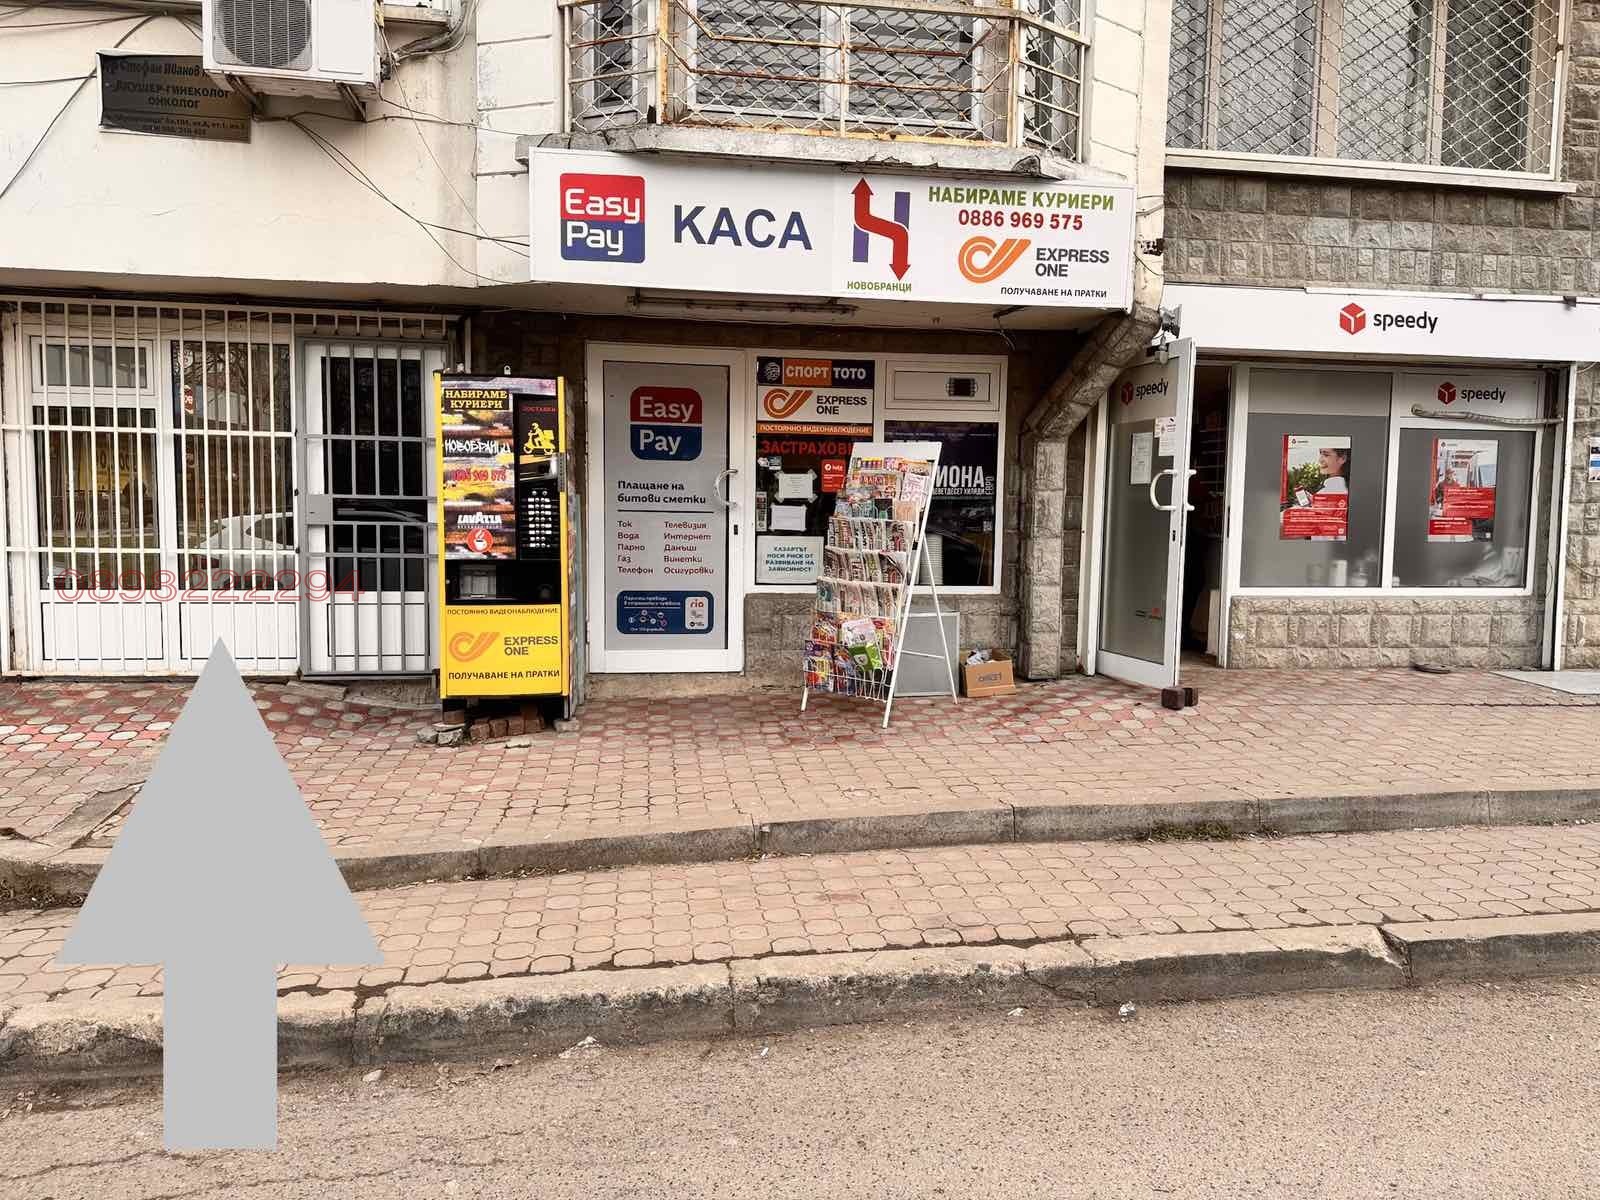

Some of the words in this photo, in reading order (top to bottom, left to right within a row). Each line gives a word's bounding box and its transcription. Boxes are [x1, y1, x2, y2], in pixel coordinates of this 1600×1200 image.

[928, 186, 1026, 207] НАБИРАМЕ
[1033, 192, 1114, 211] КУРИЕРИ
[565, 188, 640, 224] Easy
[958, 210, 1004, 227] 0886
[1011, 212, 1043, 229] 969
[1050, 214, 1083, 230] 575
[674, 205, 813, 250] КАСА
[566, 221, 624, 256] Pay
[1036, 247, 1110, 263] EXPRESS
[1035, 263, 1068, 277] ONE
[847, 281, 912, 293] НОВОБРАНЦИ
[1000, 286, 1058, 297] ПОЛУЧАВАНЕ
[1060, 288, 1072, 297] НА
[1074, 289, 1107, 298] ПРАТКИ
[1373, 311, 1438, 334] speedy
[785, 365, 829, 378] СПОРТ
[833, 367, 866, 379] ТОТО
[445, 390, 507, 399] НАБИРАМЕ
[1136, 378, 1169, 400] speedy
[817, 395, 867, 406] EXPRESS
[1461, 387, 1506, 403] speedy
[450, 400, 503, 408] КУРИЕРИ
[639, 396, 694, 422] Easy
[817, 406, 839, 415] ONE
[639, 429, 682, 455] Pay
[935, 465, 985, 487] ИОНА
[617, 480, 669, 491] Плащане
[671, 483, 685, 491] на
[617, 493, 661, 503] битови
[662, 494, 706, 504] сметки
[457, 511, 502, 524] LAVAZZA
[617, 520, 632, 528] Ток
[664, 521, 707, 530] Телевизия
[617, 532, 640, 541] Вода
[664, 533, 712, 541] Интернет
[617, 543, 645, 552] Парно
[664, 544, 697, 552] Данъци
[617, 555, 631, 563] Газ
[664, 555, 703, 563] Винетки
[617, 566, 654, 575] Телефон
[664, 567, 714, 575] Осигуровки
[504, 636, 558, 646] EXPRESS
[504, 646, 529, 656] ONE
[448, 672, 509, 680] ПОЛУЧАВАНЕ
[525, 670, 560, 678] ПРАТКИ
